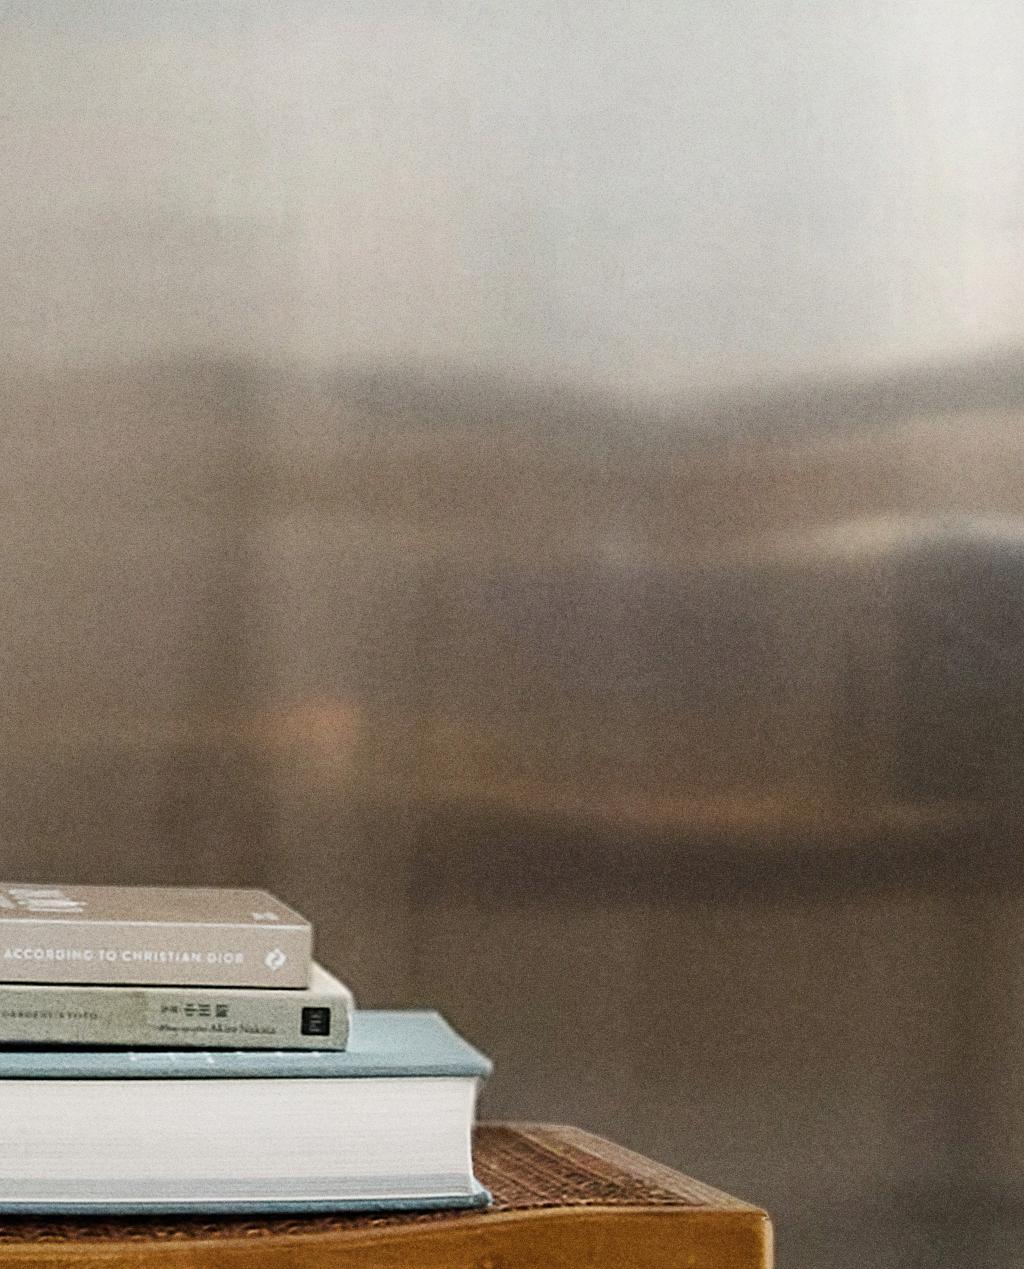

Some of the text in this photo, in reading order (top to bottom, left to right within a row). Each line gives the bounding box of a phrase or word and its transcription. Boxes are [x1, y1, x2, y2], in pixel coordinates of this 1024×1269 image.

[4, 947, 93, 961] ACCORDING
[99, 950, 117, 962] TO
[122, 950, 201, 962] CHRISTIAN
[207, 952, 244, 964] DIOR
